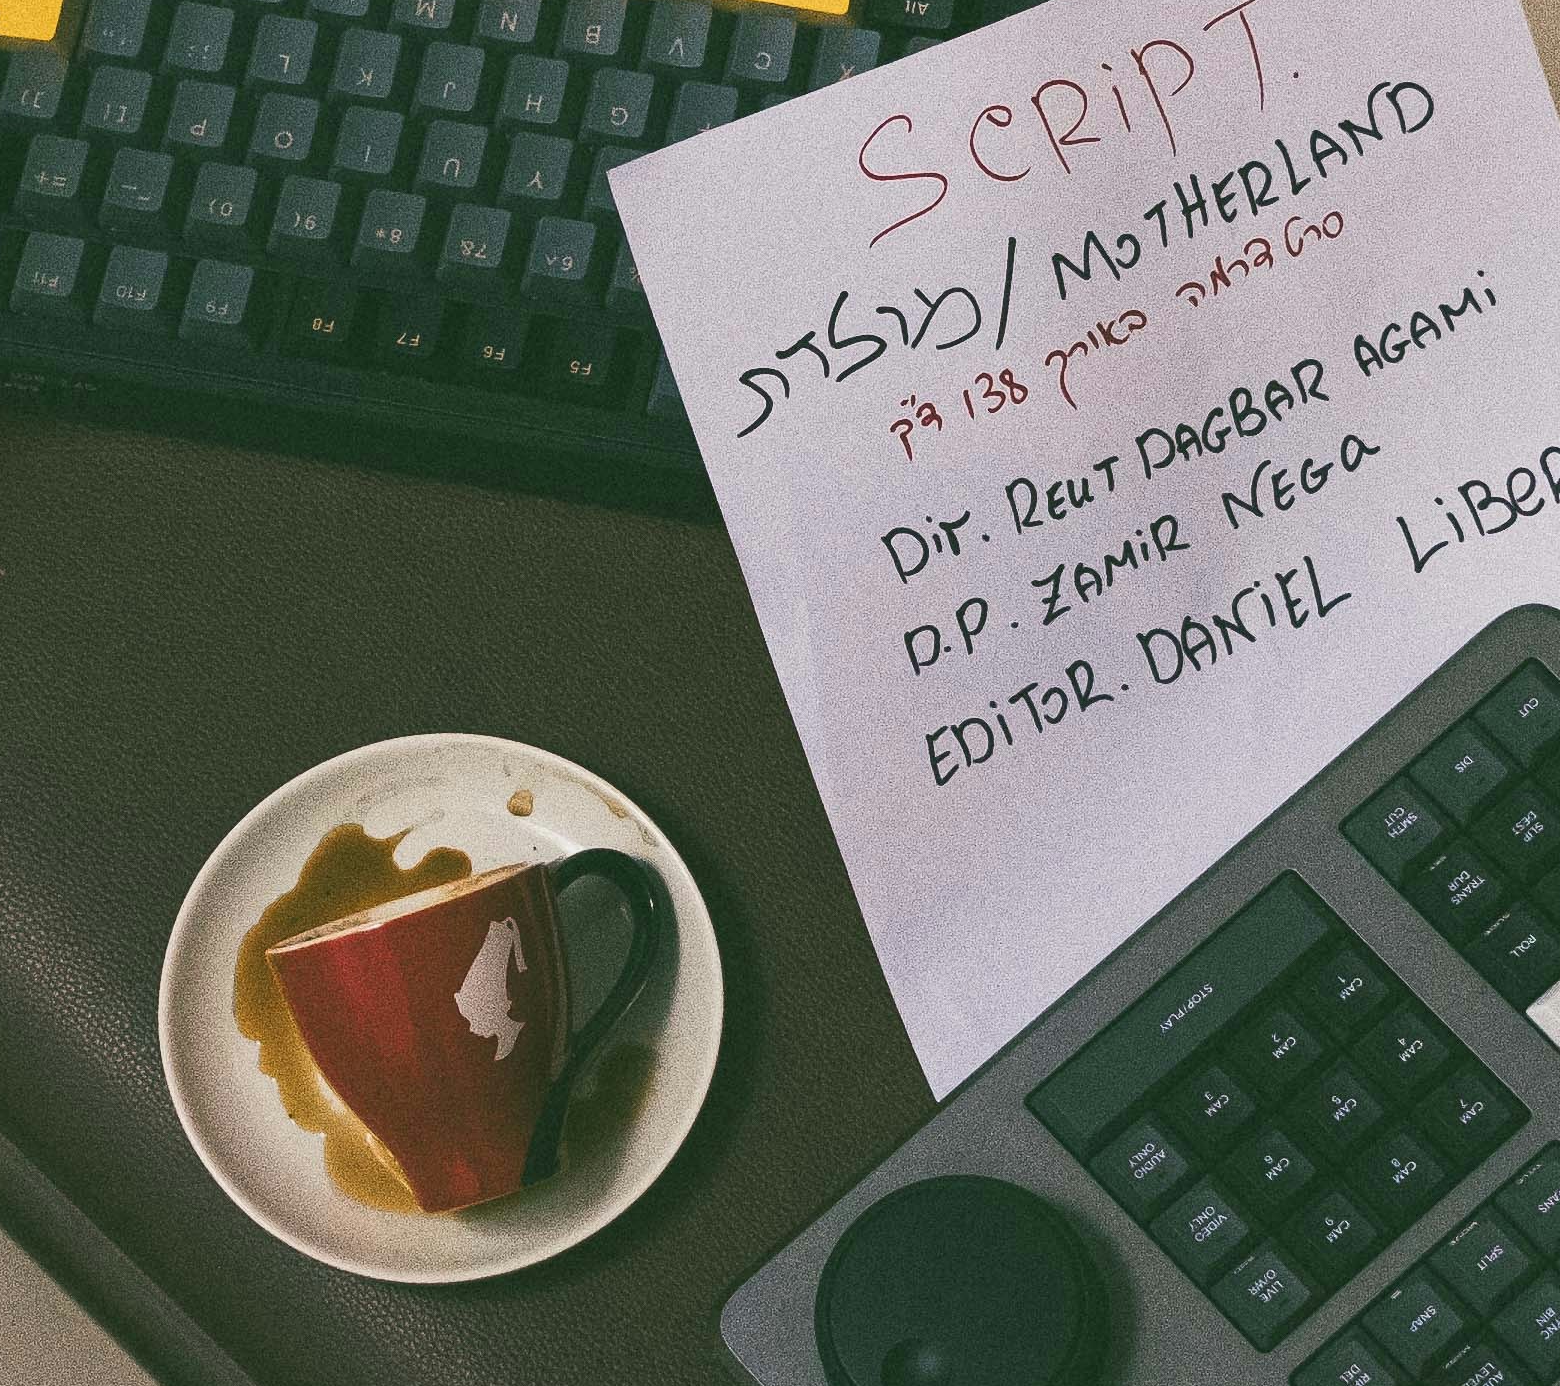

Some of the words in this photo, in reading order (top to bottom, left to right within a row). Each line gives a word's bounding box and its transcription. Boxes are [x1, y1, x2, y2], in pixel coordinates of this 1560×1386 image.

[499, 9, 518, 31] N
[584, 24, 601, 44] B
[668, 37, 686, 57] V
[276, 52, 290, 72] L
[357, 66, 372, 86] K
[114, 283, 147, 303] F10
[203, 298, 229, 316] F9
[310, 316, 334, 333] F8
[396, 330, 421, 347] F7
[481, 344, 506, 361] F6
[568, 359, 592, 376] F5
[964, 365, 1030, 416] 138
[1137, 359, 1328, 477] DAGBAR
[1516, 694, 1540, 718] CUT
[1452, 753, 1473, 774] DIS
[1381, 804, 1405, 827] CUT
[1386, 809, 1418, 840] SMTH
[1509, 808, 1538, 836] DEST
[1519, 819, 1544, 843] SLIP
[1445, 868, 1471, 893] DUR
[1448, 873, 1484, 907] TRANS
[1508, 932, 1537, 960] ROLL
[1336, 974, 1364, 1001] CAM
[1156, 980, 1214, 1035] STOP/PLAY
[1270, 1034, 1297, 1060] CAM
[1396, 1036, 1424, 1063] CAM
[1203, 1091, 1231, 1118] CAM
[1331, 1095, 1359, 1122] CAM
[1457, 1098, 1485, 1125] CAM
[1125, 1139, 1157, 1170] ONLY
[1131, 1146, 1167, 1181] AUDIO
[1263, 1155, 1291, 1182] CAM
[1390, 1157, 1418, 1185] CAM
[1185, 1202, 1217, 1234] ONLY
[1192, 1210, 1227, 1245] VIDEO
[1323, 1217, 1351, 1244] CAM
[1474, 1243, 1504, 1272] SPLIT
[1257, 1278, 1284, 1304] LIVE
[1405, 1303, 1437, 1334] SNAP
[1533, 1305, 1556, 1327] BIN
[1337, 1362, 1361, 1385] DEL
